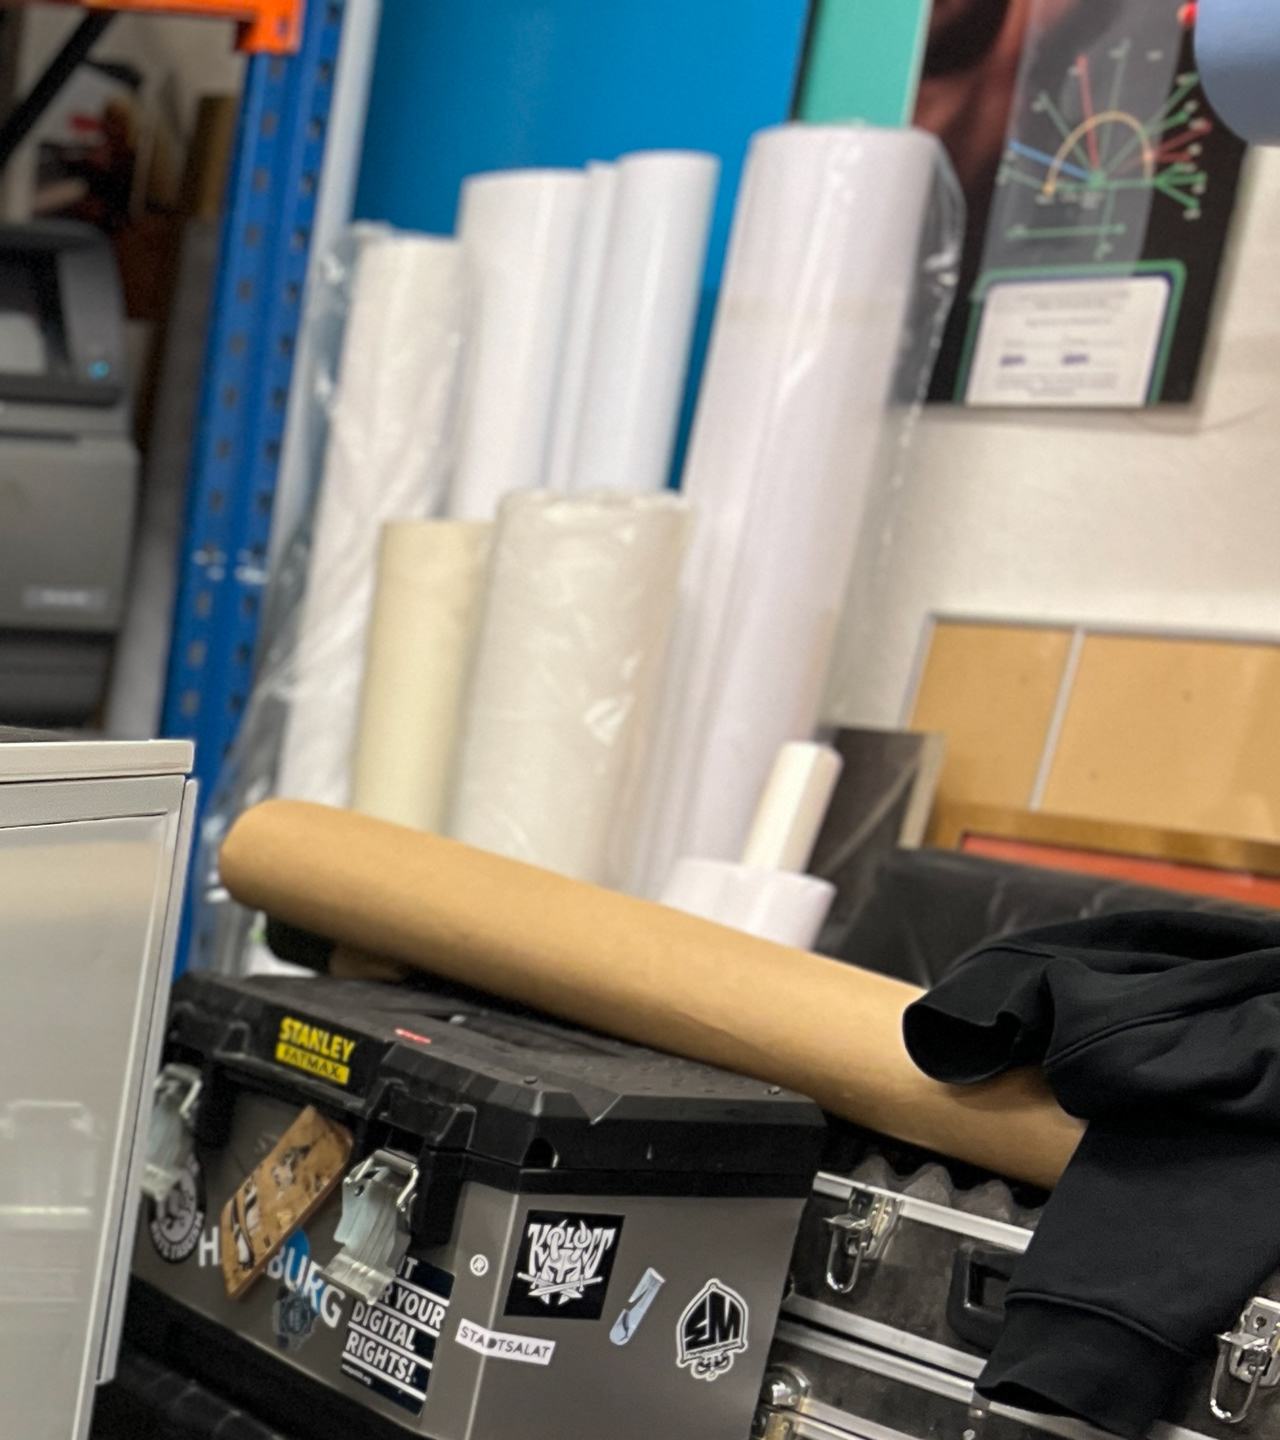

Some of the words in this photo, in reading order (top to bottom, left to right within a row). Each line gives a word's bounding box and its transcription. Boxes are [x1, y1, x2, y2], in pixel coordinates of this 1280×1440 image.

[279, 1016, 355, 1063] STANLEY
[199, 1226, 345, 1328] HBURG
[351, 1300, 416, 1351] DIGITAL
[395, 1285, 446, 1330] YOUR
[345, 1331, 417, 1384] RIGHTS!
[460, 1326, 551, 1359] STADTSALAT
